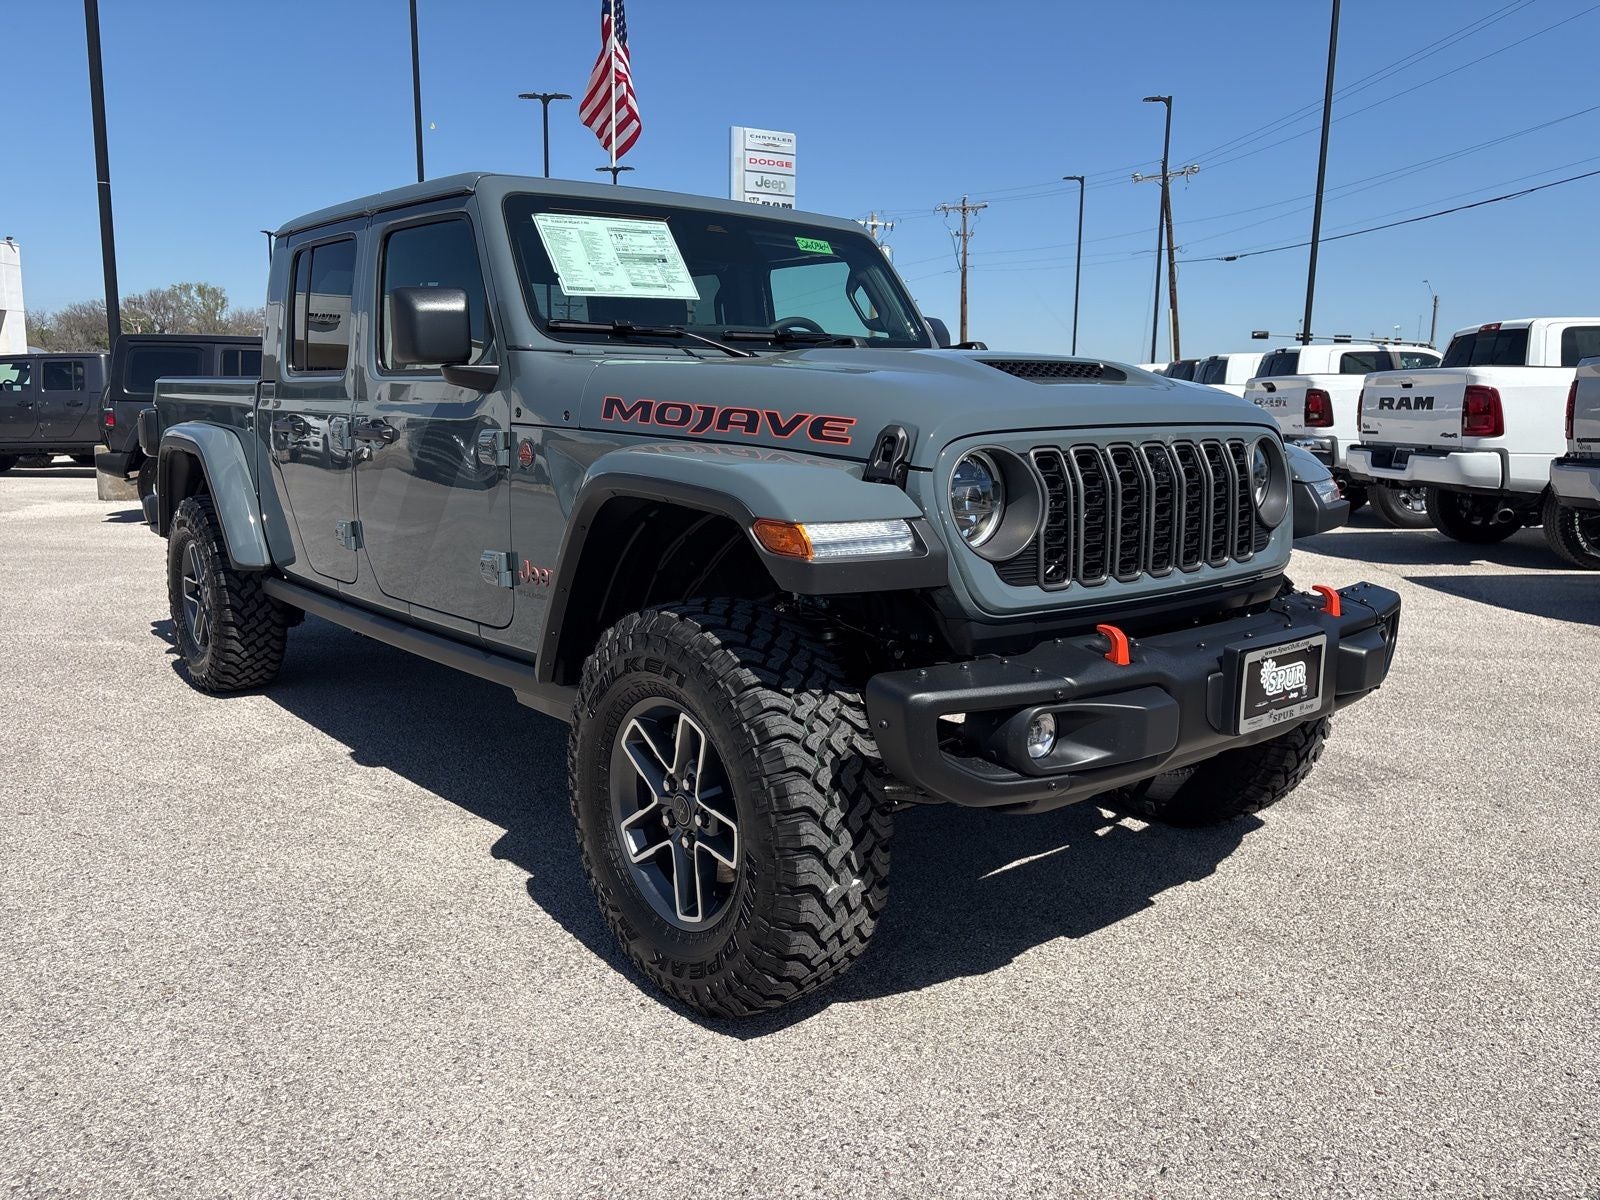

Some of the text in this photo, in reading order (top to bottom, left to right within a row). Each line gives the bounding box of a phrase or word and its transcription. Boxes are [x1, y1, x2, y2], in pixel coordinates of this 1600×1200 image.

[750, 134, 792, 143] CHRYSLER
[749, 157, 792, 168] DODGE
[755, 176, 786, 192] Jeep
[1379, 396, 1434, 410] RAM
[601, 396, 857, 445] MOJAVE
[1267, 663, 1305, 694] SPUR
[1272, 709, 1294, 723] SPUR
